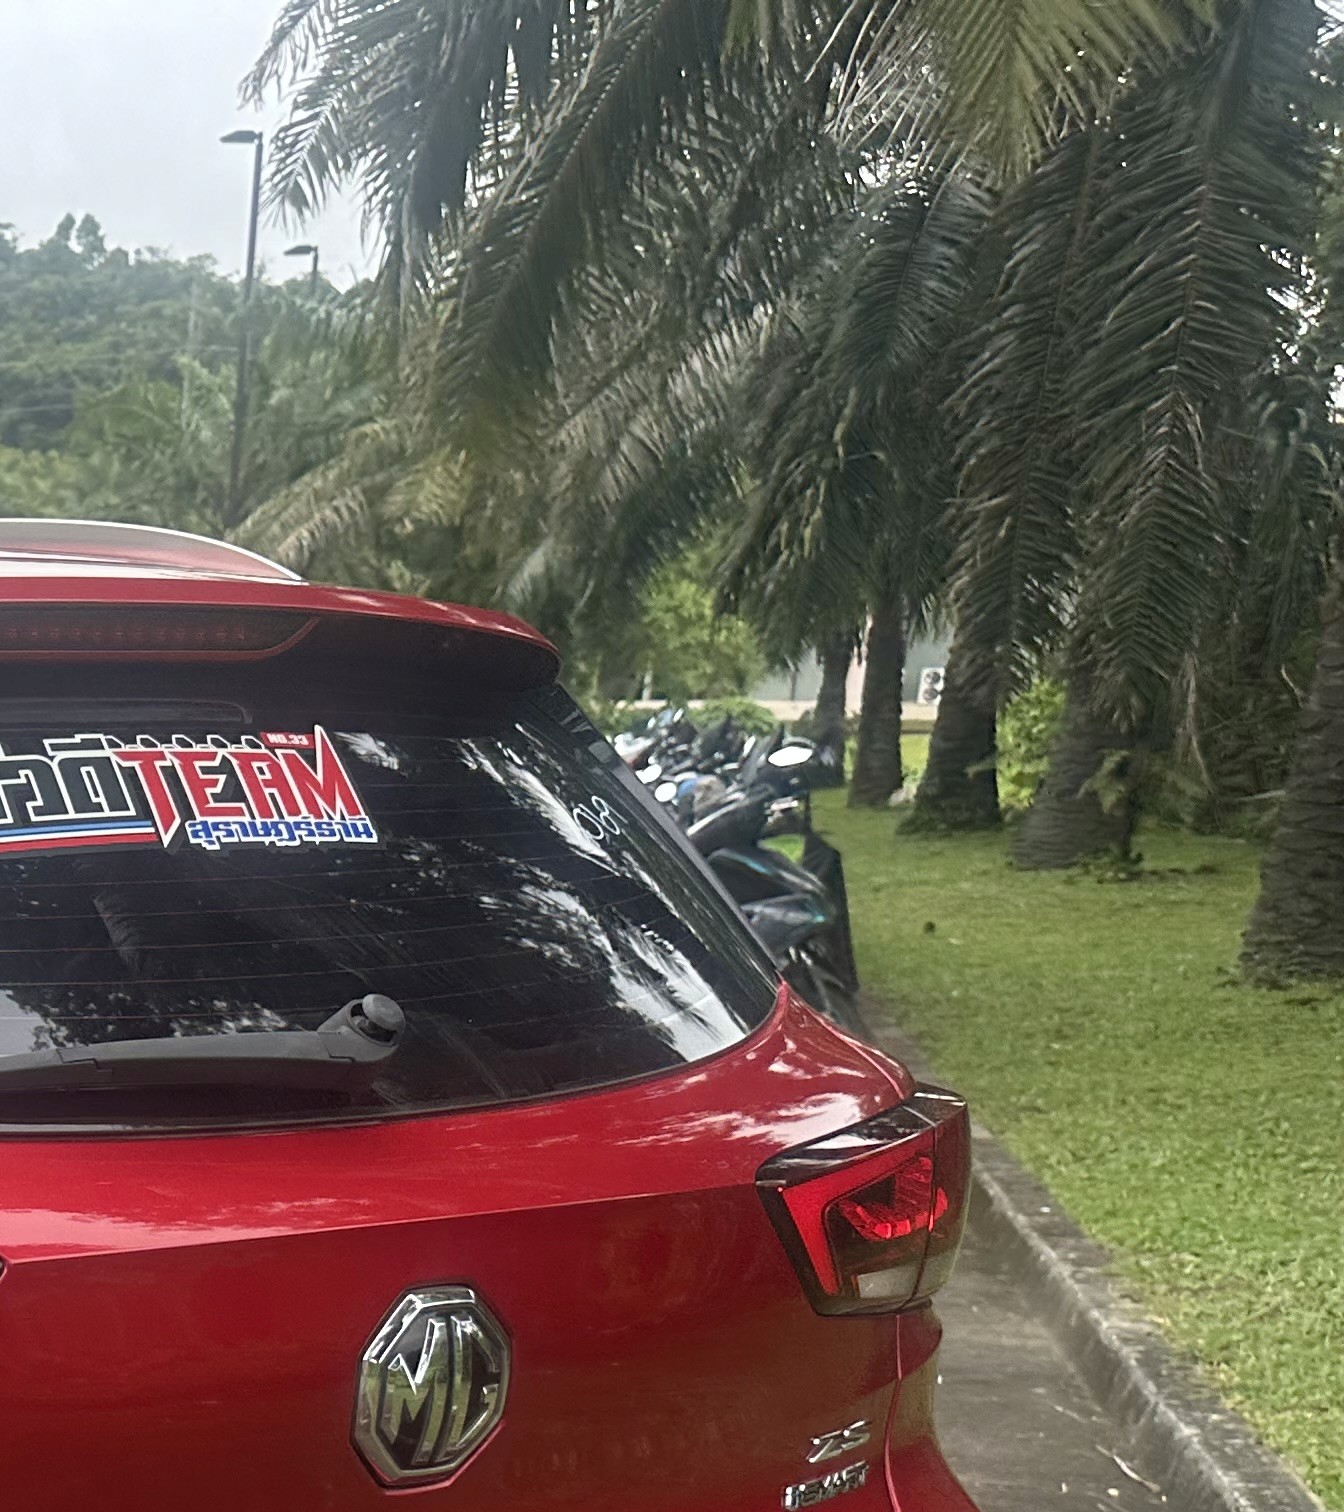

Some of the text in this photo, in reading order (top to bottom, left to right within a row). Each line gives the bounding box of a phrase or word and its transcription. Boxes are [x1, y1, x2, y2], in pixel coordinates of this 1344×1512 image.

[110, 724, 364, 848] TEAM
[375, 1310, 502, 1471] MG
[806, 1420, 871, 1463] ZS
